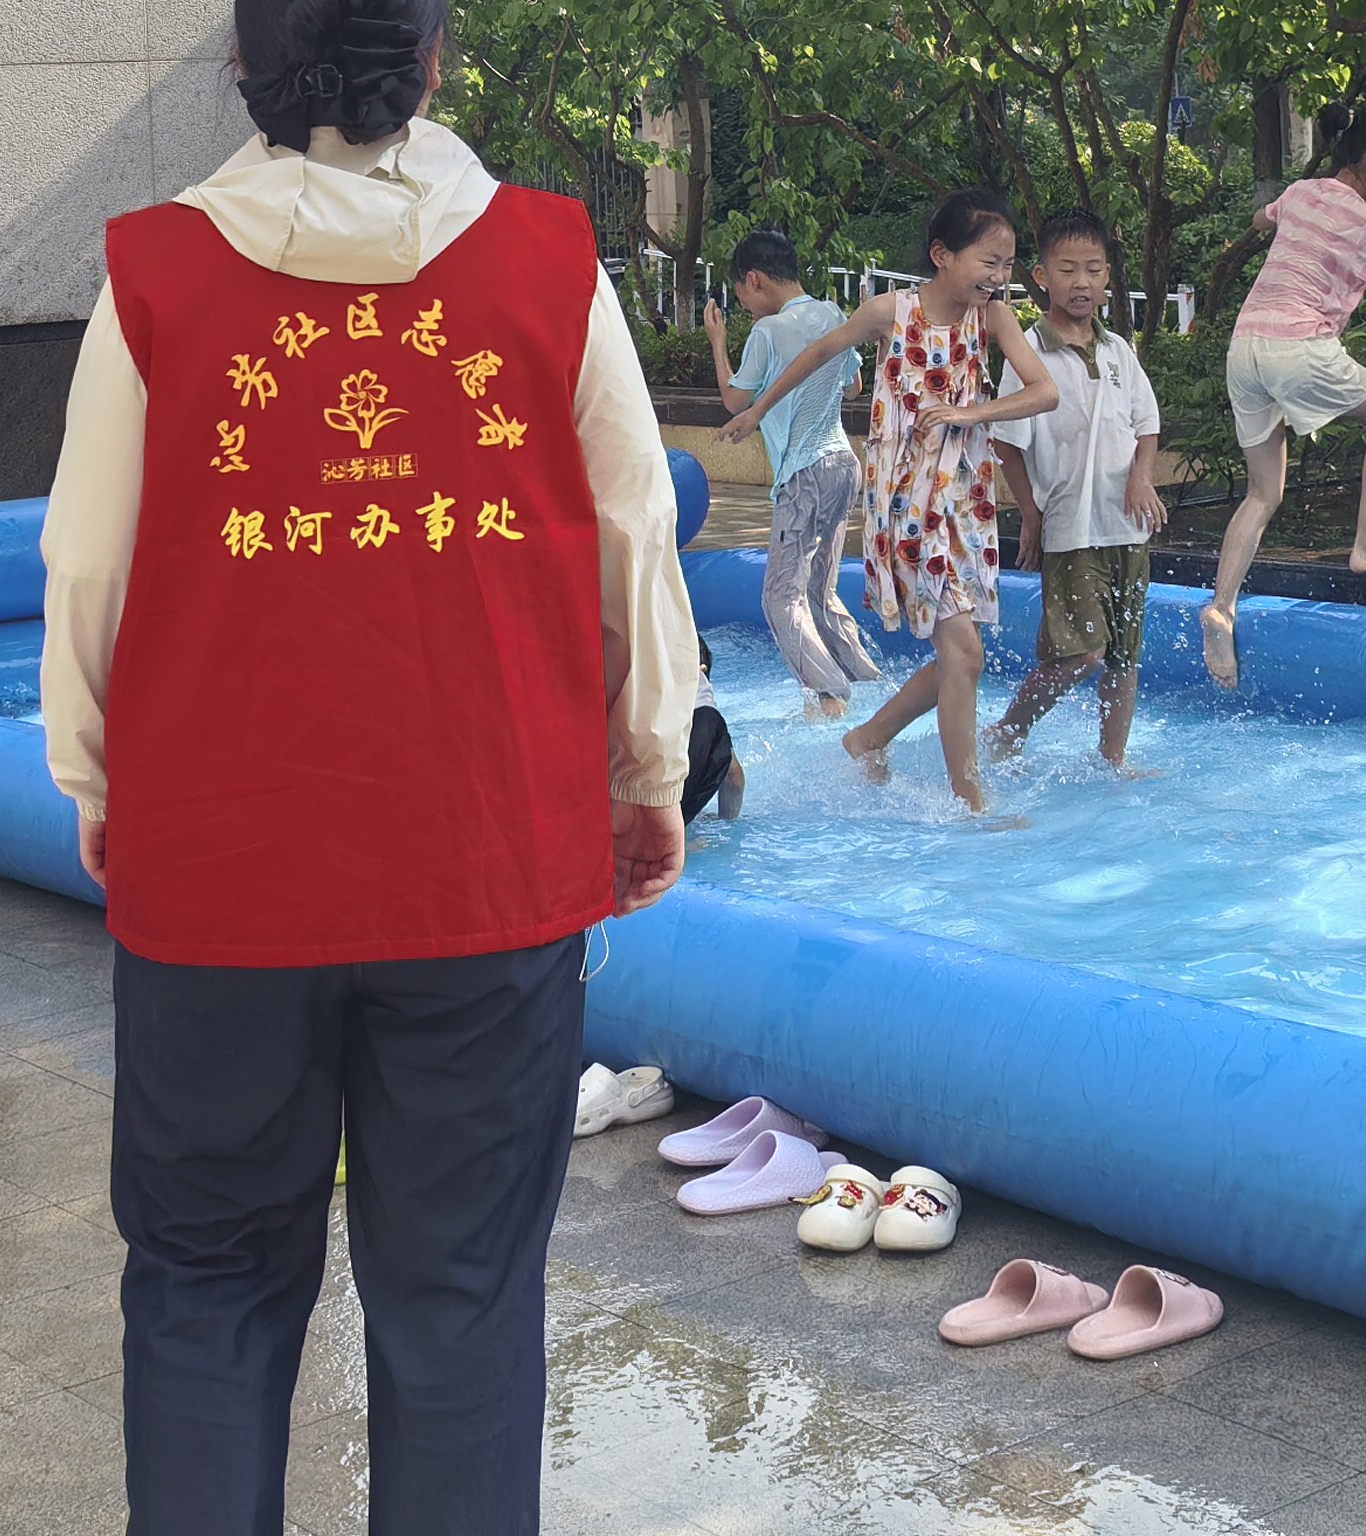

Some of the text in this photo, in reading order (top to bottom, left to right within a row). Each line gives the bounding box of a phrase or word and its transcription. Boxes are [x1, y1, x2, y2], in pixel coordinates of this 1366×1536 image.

[321, 454, 417, 483] 沁芳社区
[220, 491, 525, 559] 银河办事处
